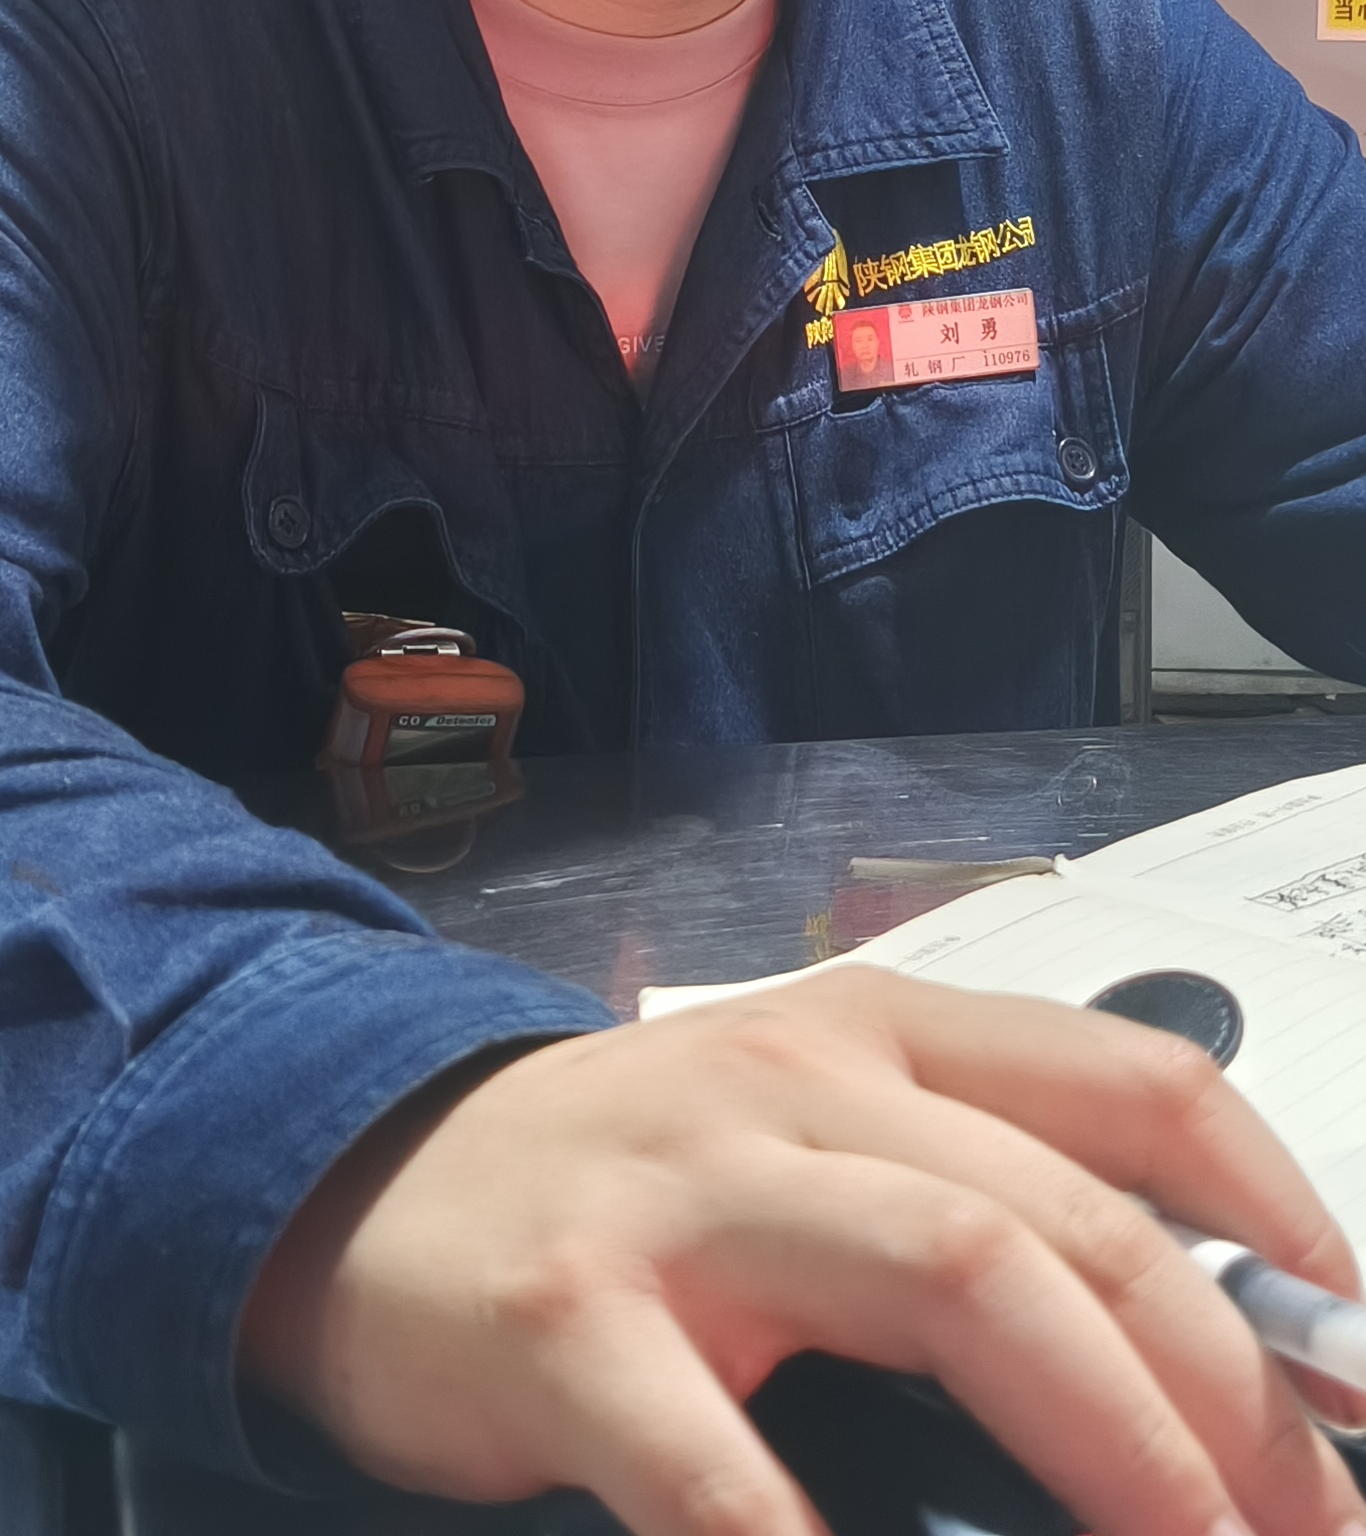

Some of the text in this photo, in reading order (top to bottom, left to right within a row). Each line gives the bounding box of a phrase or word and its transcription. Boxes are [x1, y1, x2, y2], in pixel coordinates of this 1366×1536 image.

[853, 216, 1036, 297] 陕钢集团龙钢公司
[921, 292, 1029, 318] 陕钢集团龙钢公司
[617, 335, 665, 354] GIVE
[903, 356, 966, 378] 轧钢厂
[399, 716, 420, 726] CO
